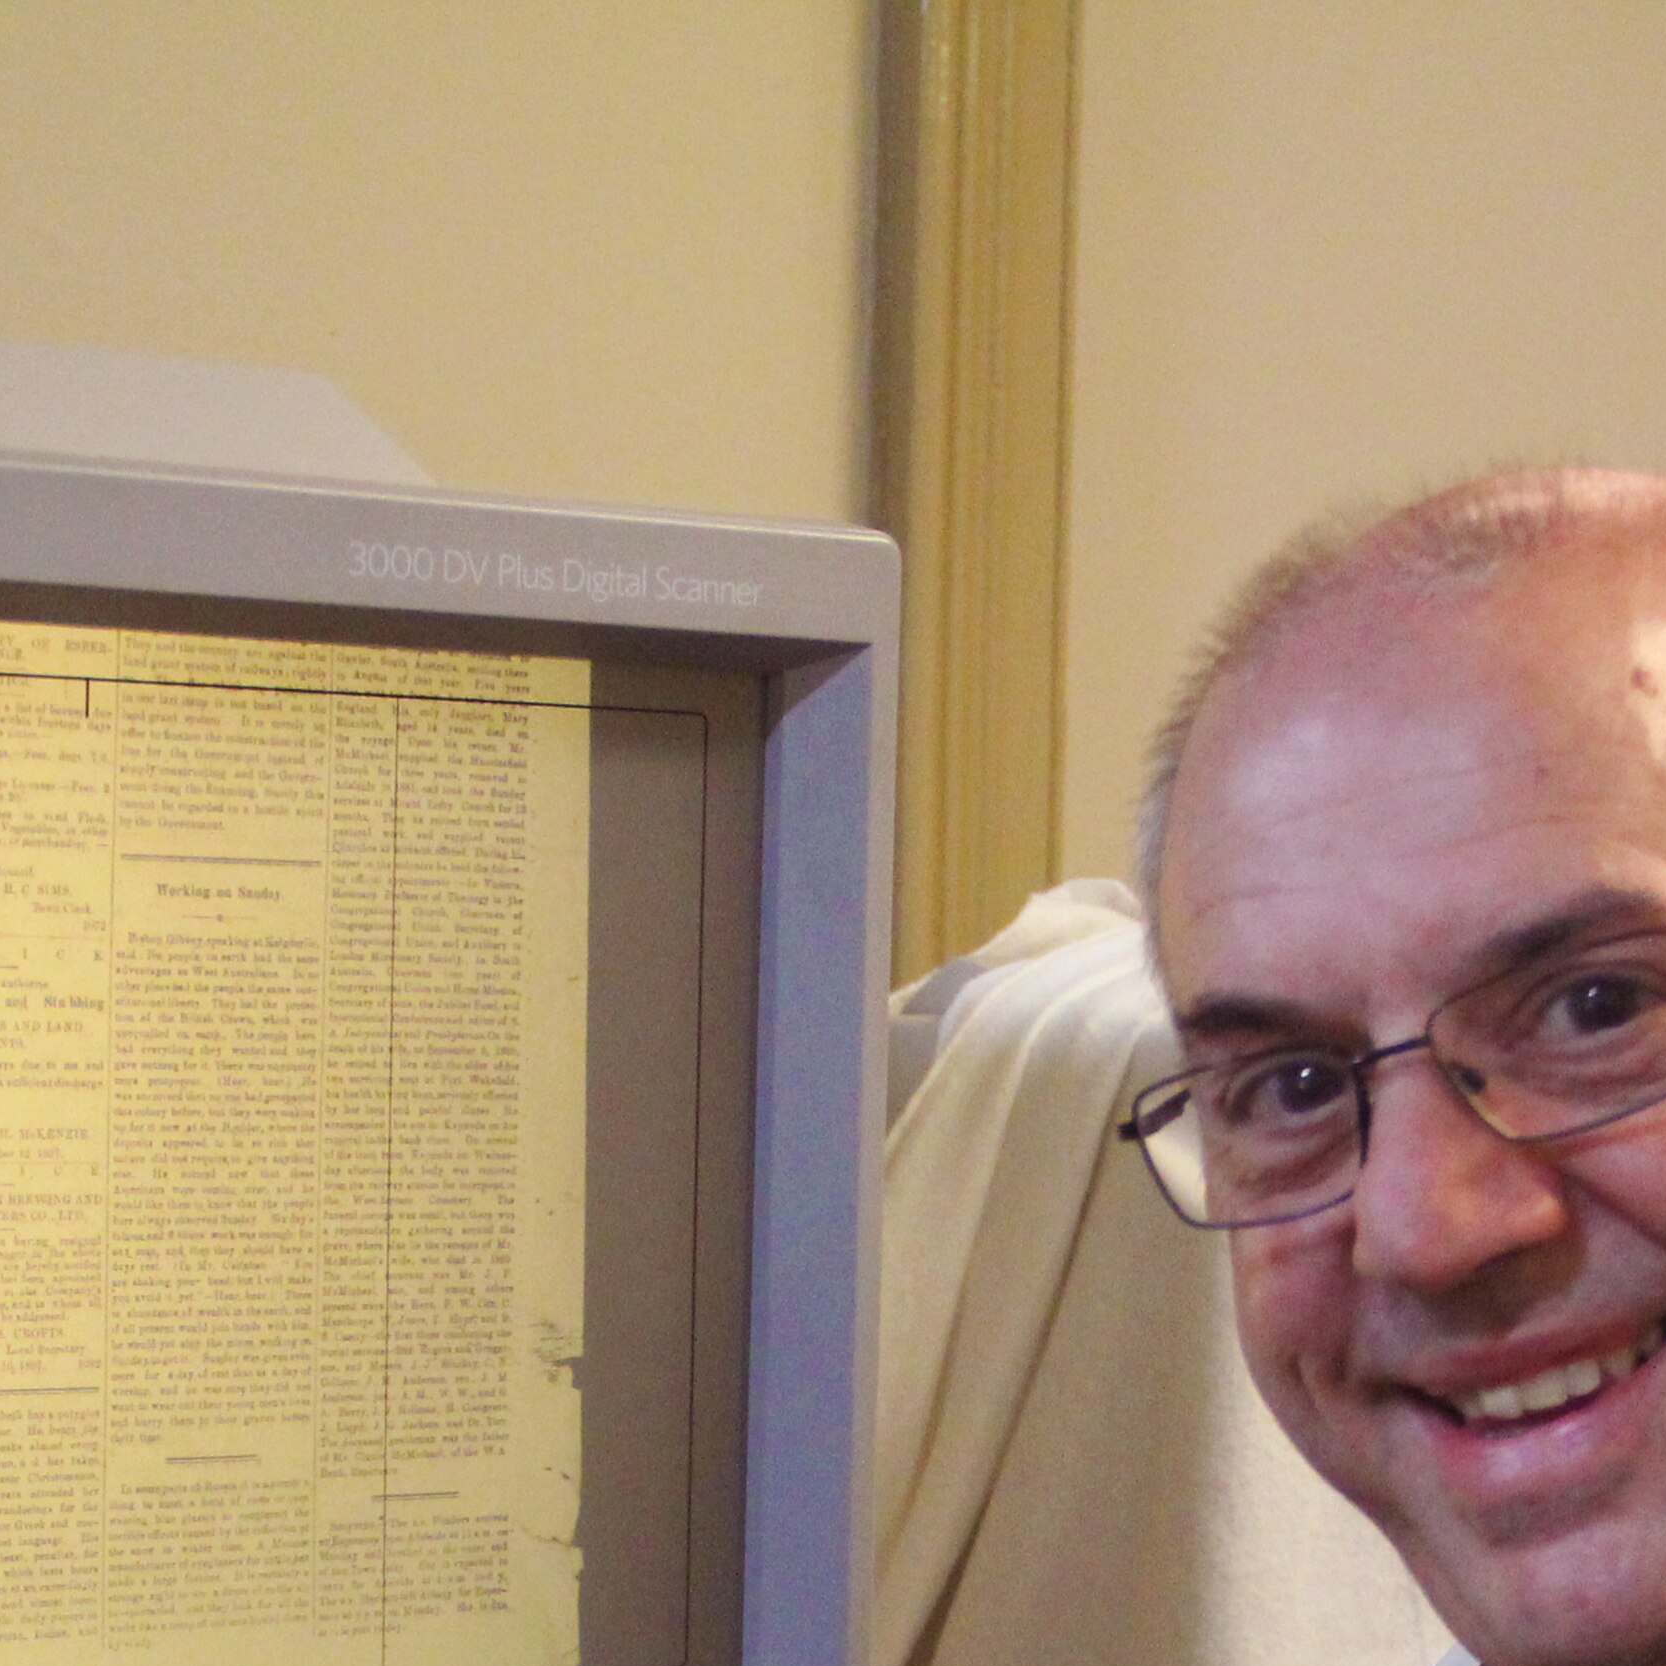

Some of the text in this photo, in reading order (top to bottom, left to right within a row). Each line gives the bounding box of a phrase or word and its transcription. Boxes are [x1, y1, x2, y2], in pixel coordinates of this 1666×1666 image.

[348, 541, 763, 606] 3000 DV Plus Digital Scanner
[156, 883, 211, 899] Working
